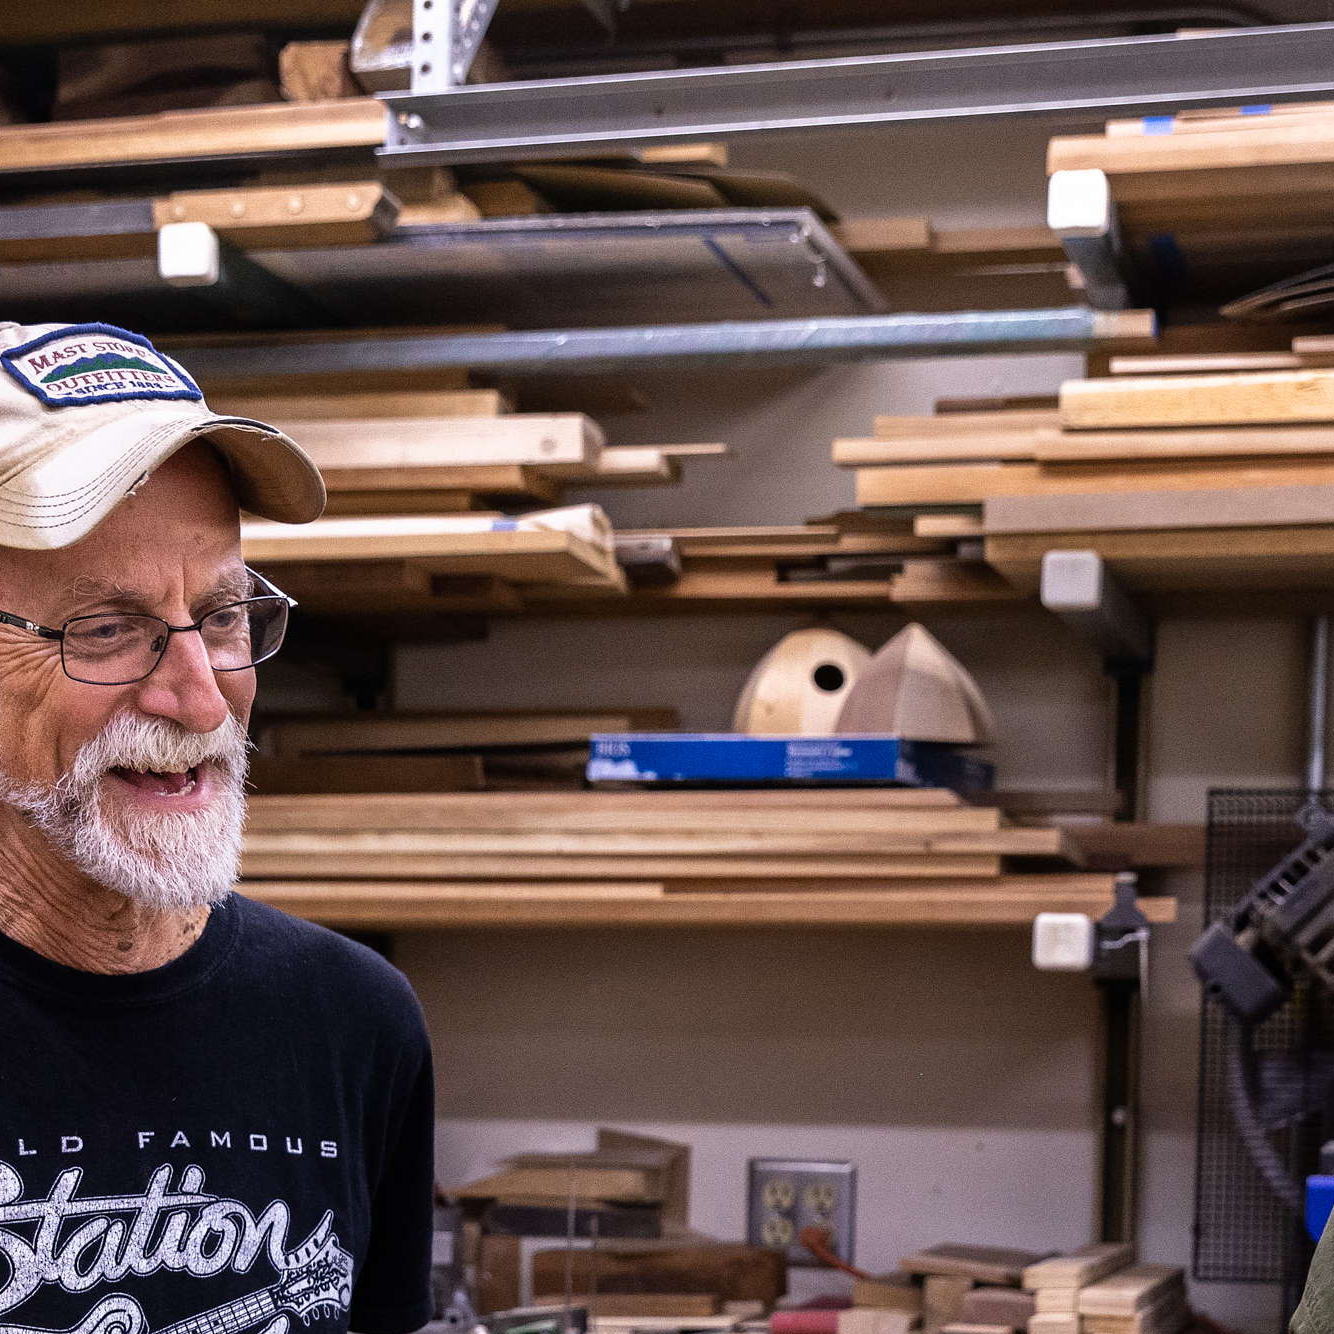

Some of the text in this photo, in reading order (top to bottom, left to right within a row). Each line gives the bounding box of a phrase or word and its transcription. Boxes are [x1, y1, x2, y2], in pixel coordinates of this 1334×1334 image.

[27, 342, 87, 375] MAST
[45, 369, 176, 393] OUTFITTERS
[74, 381, 126, 395] SINCE
[138, 1130, 339, 1159] FAMOUS
